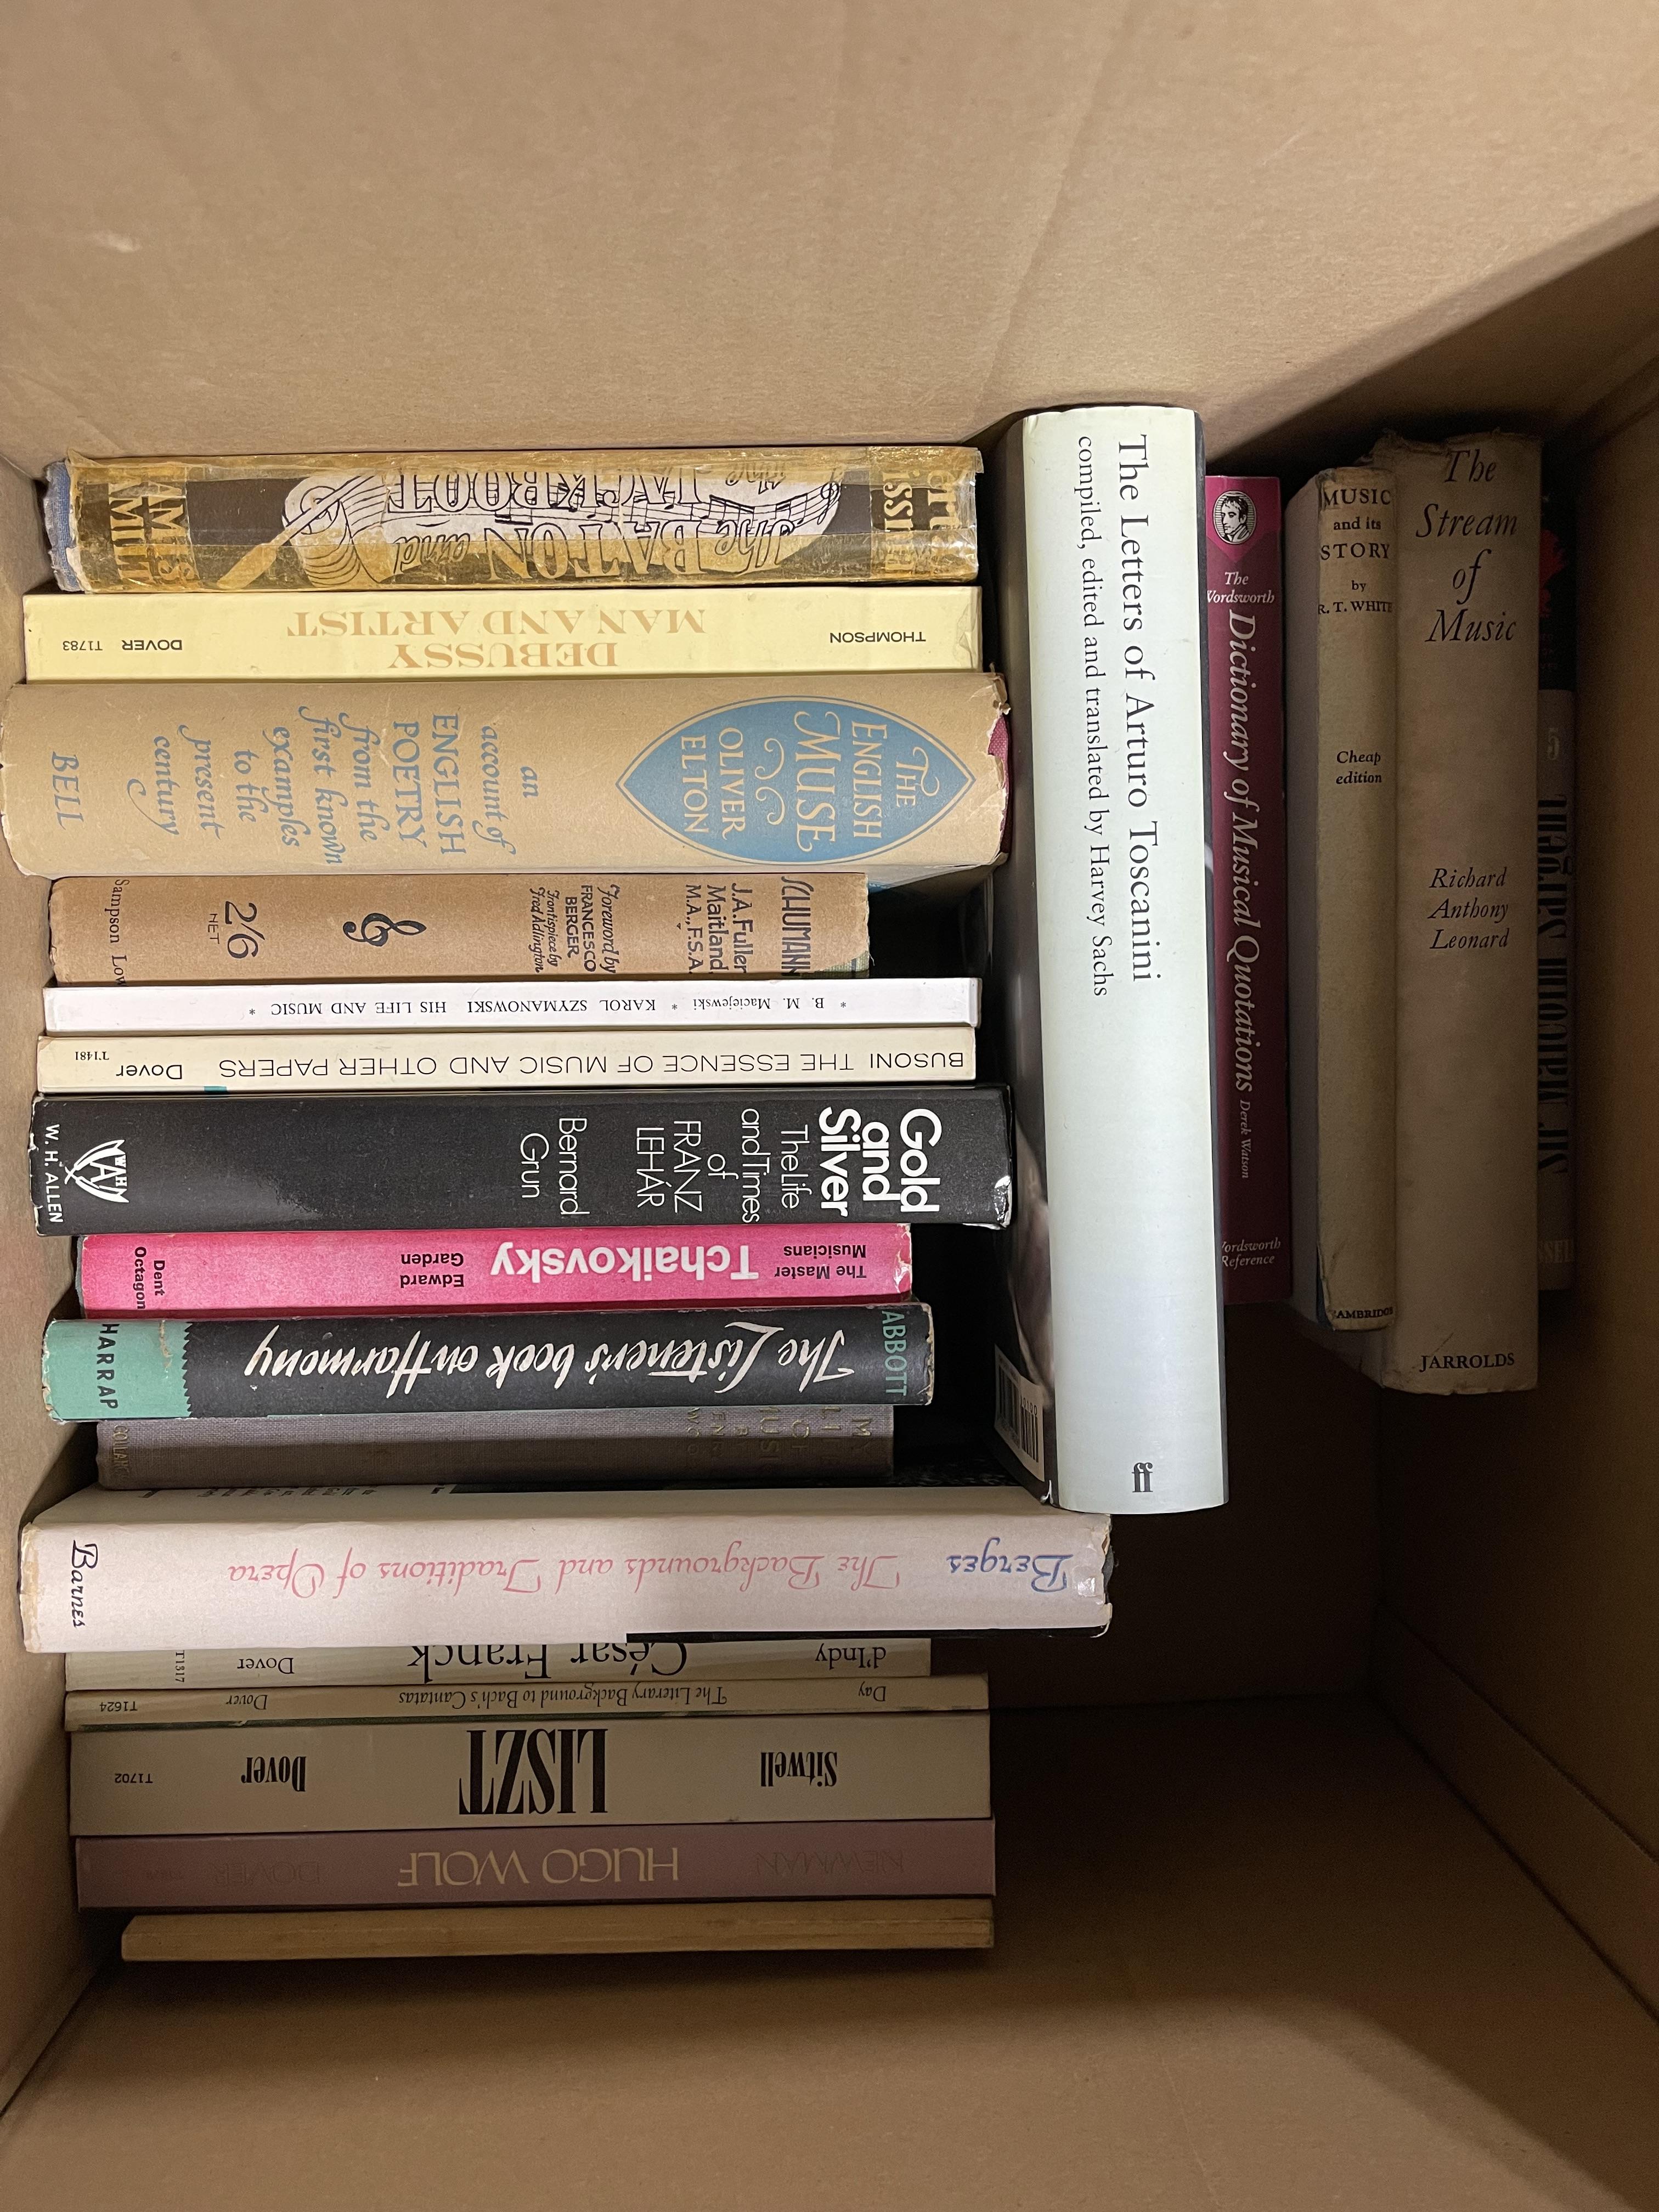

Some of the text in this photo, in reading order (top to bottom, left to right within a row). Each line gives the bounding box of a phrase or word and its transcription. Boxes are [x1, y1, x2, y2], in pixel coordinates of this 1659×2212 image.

[1444, 448, 1497, 483] The
[1323, 488, 1391, 505] MUSIC
[1333, 516, 1381, 530] and its
[1415, 503, 1517, 538] Stream
[392, 521, 795, 579] The BATON and
[1320, 543, 1390, 560] STORY
[1224, 572, 1249, 585] The
[1351, 580, 1366, 592] by
[1452, 549, 1492, 605] of
[286, 609, 706, 637] MAN AND ARTIST
[1318, 601, 1347, 614] R. T.
[1424, 608, 1516, 642] Music
[62, 640, 103, 651] T1783
[122, 639, 183, 651] DOVER
[387, 641, 617, 669] DEBUSSY
[830, 631, 926, 644] THOMPSON
[1074, 436, 1114, 996] compiled, edited and translated by Harvey Sachs
[1118, 434, 1161, 982] The Letters of Arturo Toscanini
[338, 712, 391, 842] from the
[1336, 749, 1381, 765] Cheap
[51, 751, 84, 830] BELL
[127, 735, 180, 835] century
[178, 724, 225, 840] present
[233, 749, 269, 822] to the
[262, 727, 311, 847] examples
[298, 706, 349, 864] first known
[392, 721, 427, 848] POETRY
[432, 713, 466, 854] ENGLISH
[472, 725, 516, 855] account of
[520, 766, 539, 798] an
[681, 735, 709, 834] ELTON
[719, 727, 746, 840] OLIVER
[851, 721, 888, 839] ENGLISH
[1335, 770, 1382, 785] edition
[1223, 609, 1261, 1092] Dictionary of Musical Quotations
[1429, 867, 1507, 888] Richard
[104, 879, 130, 944] Sampson
[529, 887, 545, 914] Fred
[1427, 897, 1508, 923] Anthony
[207, 913, 221, 945] NET
[225, 901, 266, 959] 2/6
[543, 890, 562, 967] Frontispiece by
[565, 896, 579, 958] BERGER
[581, 884, 596, 972] FRANCESCO
[597, 884, 620, 974] Foreword by
[1429, 928, 1509, 949] Leonard
[270, 999, 656, 1016] KAROL SZYMANOWSKI HIS LIFE AND MUSIC
[692, 996, 824, 1011] B. M. Maciejewski
[75, 1051, 110, 1061] T1481
[116, 1064, 183, 1081] Dover
[219, 1053, 964, 1077] BUSONI THE ESSENCE OF MUSIC AND OTHER PAPERS
[1240, 1099, 1251, 1179] Derek Watson
[44, 1124, 64, 1223] W. H. ALLEN
[520, 1132, 549, 1199] Grun
[558, 1118, 590, 1215] Bernard
[636, 1127, 672, 1208] LEHÁR
[673, 1120, 703, 1214] FRANZ
[707, 1154, 739, 1180] of
[741, 1108, 771, 1223] and Times
[781, 1124, 813, 1209] The Life
[819, 1107, 862, 1218] Silver
[862, 1121, 901, 1201] and
[900, 1108, 942, 1212] Gold
[400, 1253, 464, 1267] Garden
[490, 1242, 759, 1283] Tchaikovsky
[783, 1244, 866, 1260] Musicians
[1222, 1254, 1275, 1270] Reference
[133, 1246, 147, 1309] Octagon
[154, 1260, 165, 1296] Dent
[400, 1274, 465, 1289] Edward
[775, 1266, 866, 1281] The Master
[96, 1324, 120, 1409] HARRAP
[244, 1325, 855, 1398] The book on Harmony
[882, 1311, 907, 1396] ABBOTT
[1419, 1353, 1514, 1372] JARROLDS
[1131, 1462, 1153, 1493] ff
[71, 1540, 98, 1628] Barnes
[228, 1540, 900, 1599] The Backgrounds and Traditions of Opera
[946, 1537, 1074, 1593] Berges
[175, 1650, 185, 1683] T1317
[237, 1657, 295, 1674] Dover
[407, 1643, 687, 1684] César Franck
[99, 1701, 137, 1712] T1624
[226, 1694, 268, 1711] Dover
[399, 1681, 727, 1710] The Literary Background to Cantatas
[857, 1682, 887, 1702] Day
[115, 1773, 154, 1784] T1702
[241, 1756, 307, 1792] Dover
[459, 1728, 608, 1815] LISZT
[760, 1752, 838, 1787] Sitwell
[397, 1847, 679, 1887] HUGO WOLF
